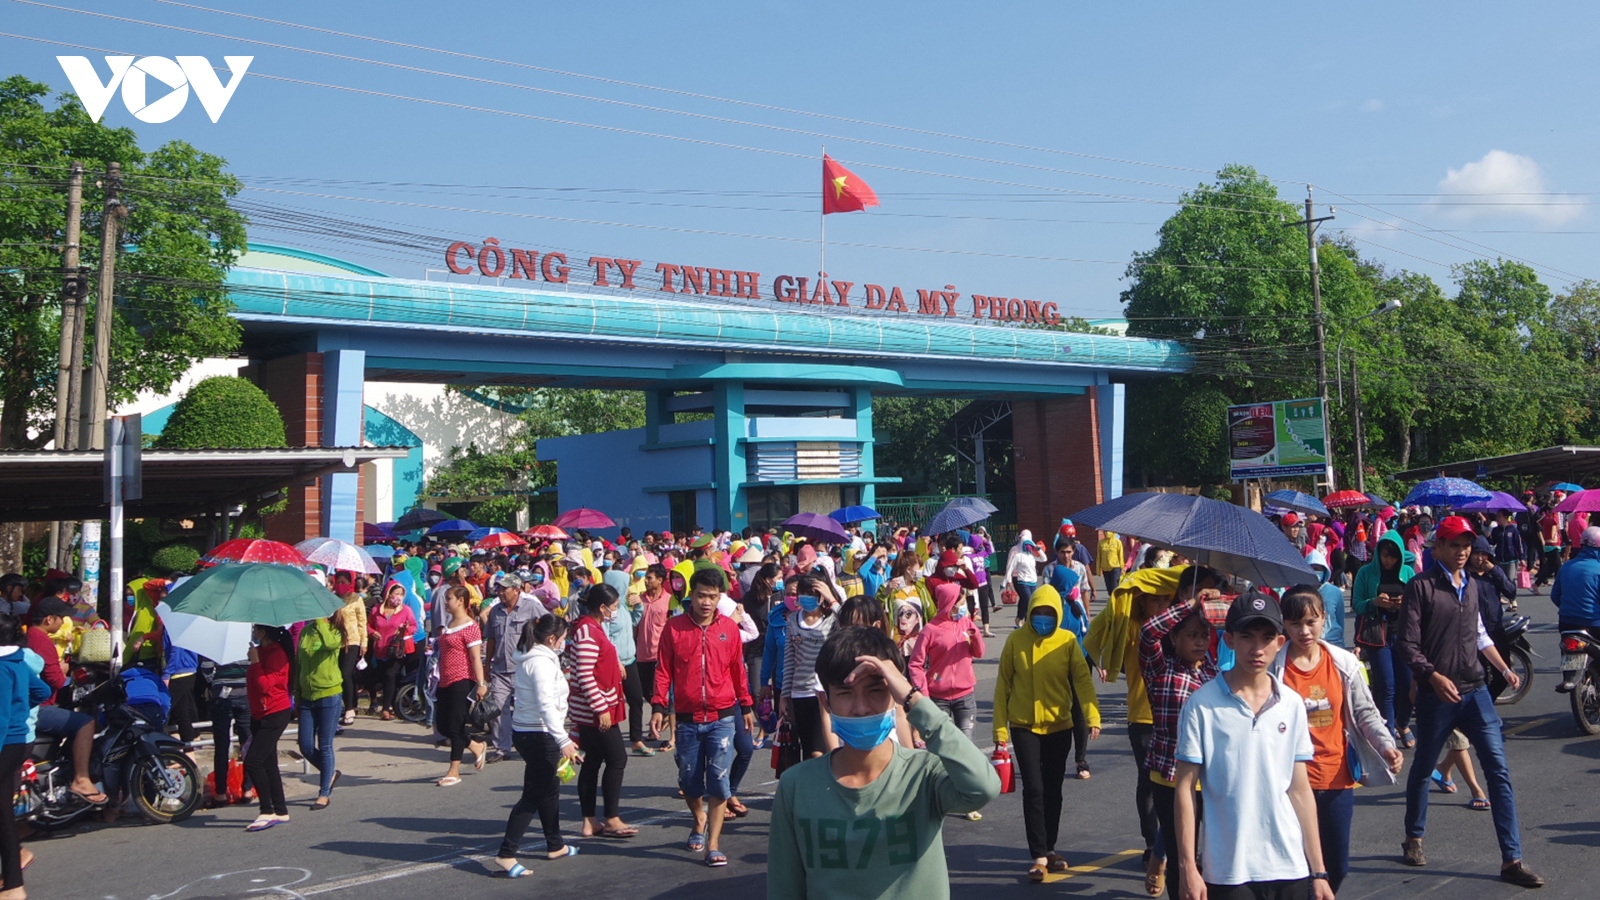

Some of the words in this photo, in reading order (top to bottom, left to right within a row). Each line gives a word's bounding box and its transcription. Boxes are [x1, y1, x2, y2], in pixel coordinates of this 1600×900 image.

[445, 237, 571, 285] CÔNG
[588, 256, 642, 289] TY
[655, 261, 760, 300] TNHH
[864, 283, 908, 313] DA
[917, 284, 960, 316] MỸ
[971, 294, 1061, 325] PHONG
[798, 810, 918, 870] 1979
